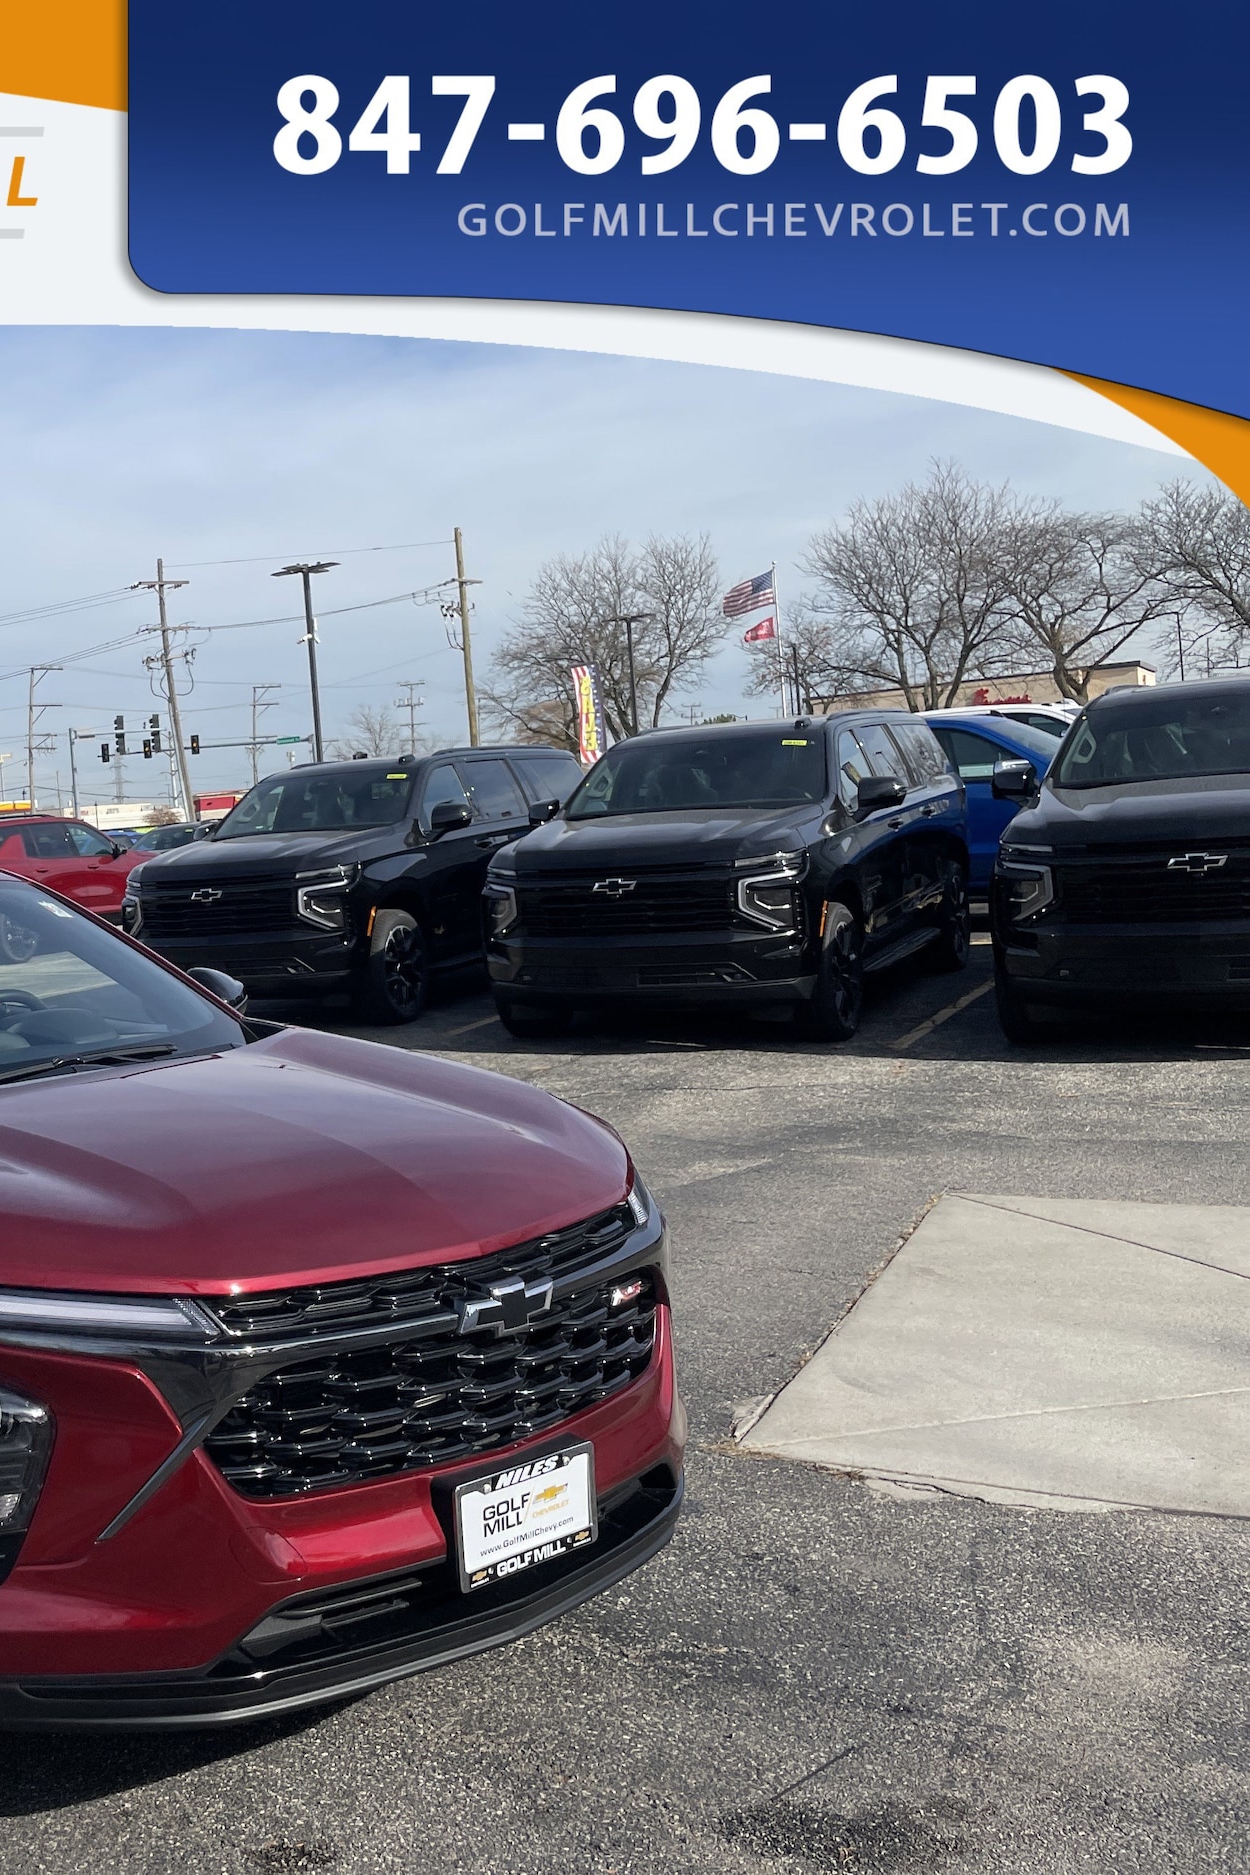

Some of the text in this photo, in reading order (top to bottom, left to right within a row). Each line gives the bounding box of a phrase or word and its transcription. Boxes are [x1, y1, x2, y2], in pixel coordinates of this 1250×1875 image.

[495, 1455, 559, 1490] NILES
[482, 1492, 530, 1522] GOLF
[480, 1516, 574, 1557] www.GolfMillChevy.com
[483, 1512, 523, 1538] MILL
[497, 1551, 533, 1577] GOLF
[533, 1540, 566, 1563] MILL
